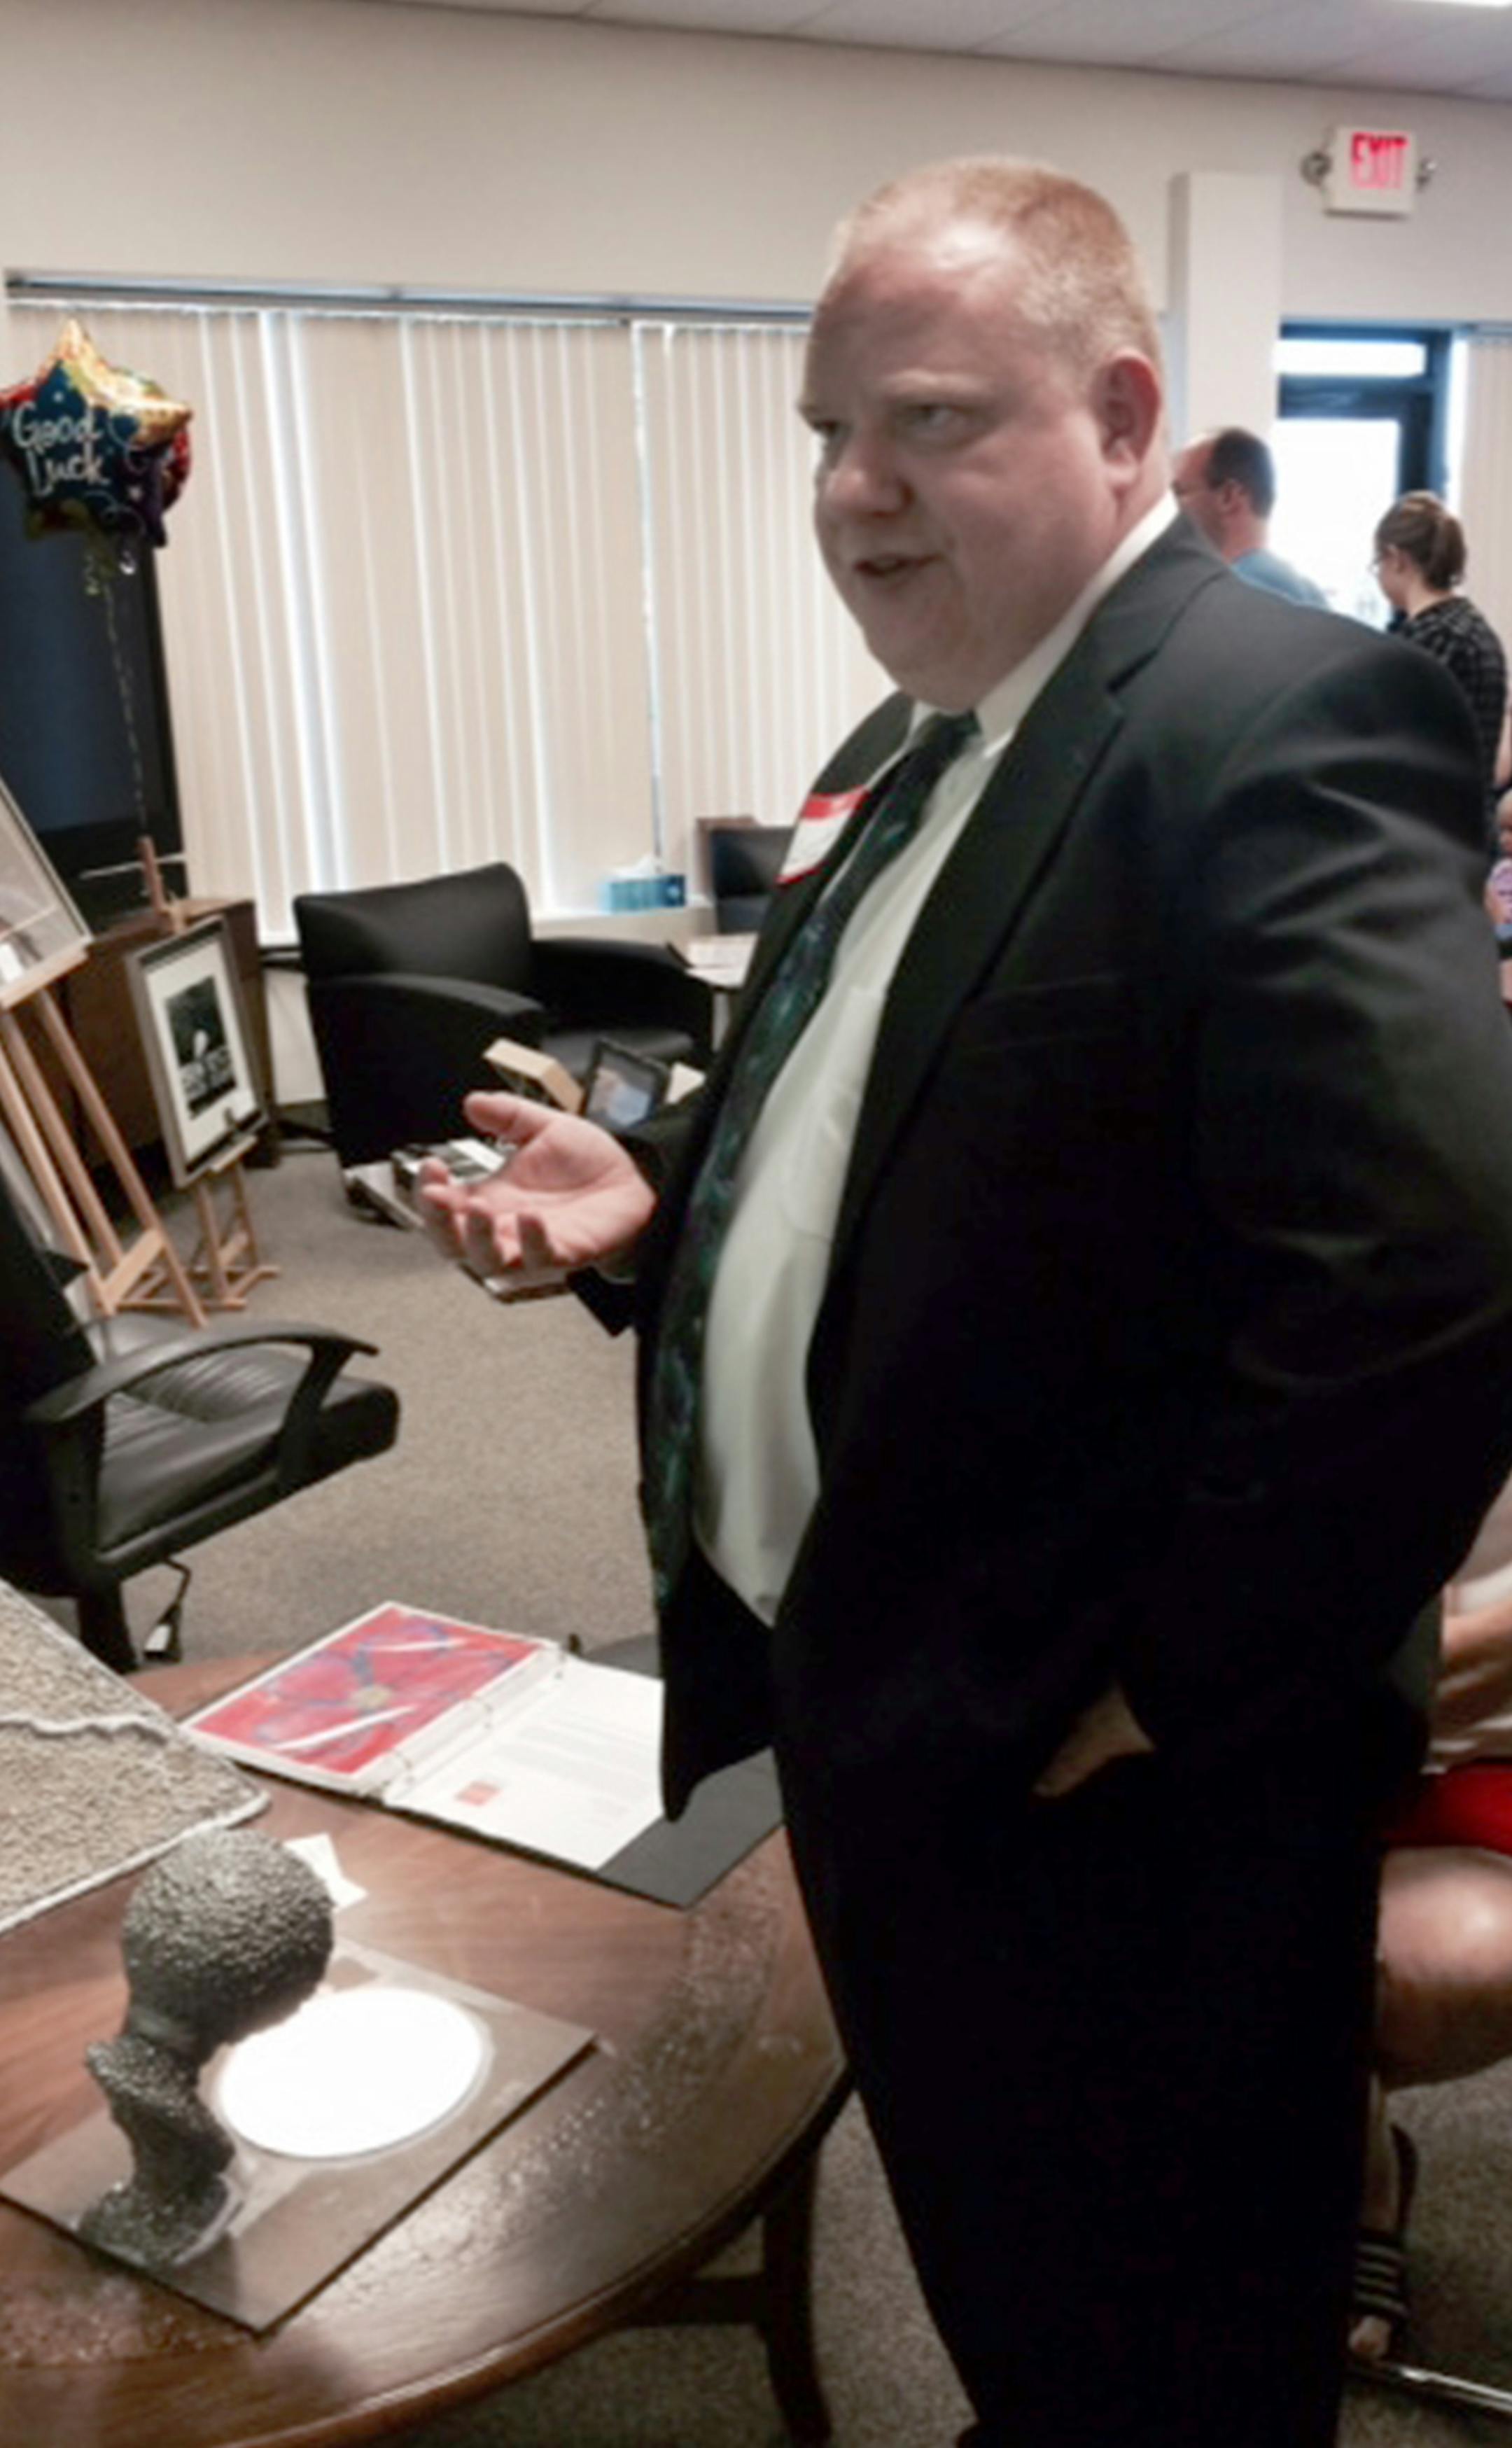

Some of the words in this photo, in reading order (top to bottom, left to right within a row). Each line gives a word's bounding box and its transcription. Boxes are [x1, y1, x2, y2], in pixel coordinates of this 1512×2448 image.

[1350, 132, 1408, 189] EXIT
[13, 401, 103, 449] Good
[26, 441, 110, 497] Luck
